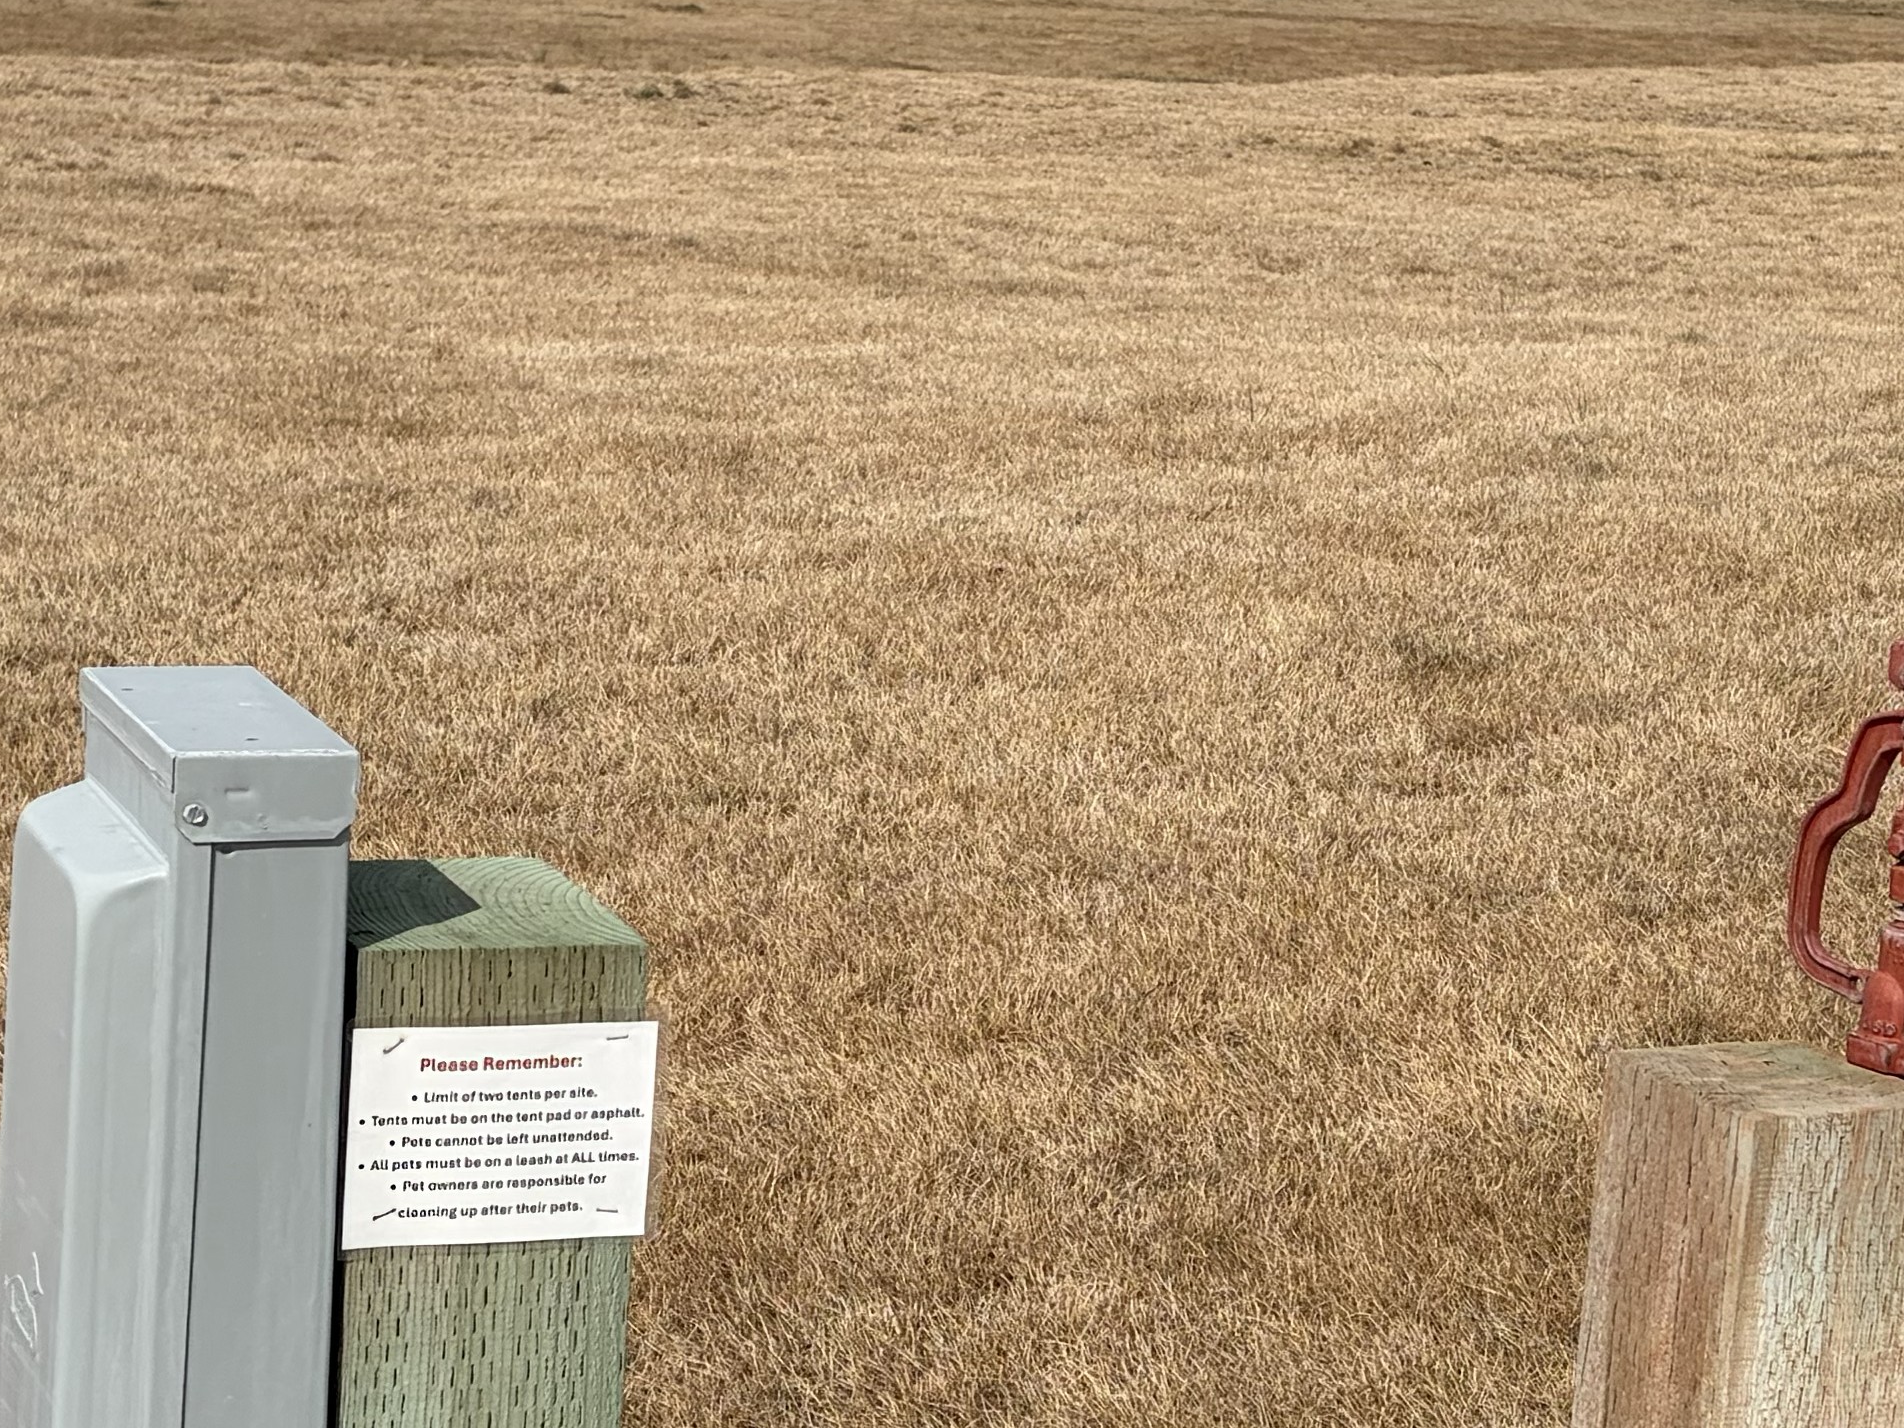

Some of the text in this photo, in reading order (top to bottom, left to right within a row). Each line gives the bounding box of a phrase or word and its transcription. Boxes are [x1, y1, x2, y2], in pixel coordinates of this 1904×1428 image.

[420, 1054, 583, 1073] Please Remember:
[424, 1086, 598, 1104] Limit of two tents per site.
[371, 1107, 645, 1127] Tents must be on the tent pad or asphalt.
[401, 1128, 613, 1148] Pets cannot be left unattended.
[369, 1151, 639, 1172] All pets must be on a leash at ALL times.
[402, 1172, 607, 1192] Pet owners are responsible for
[397, 1201, 583, 1220] cleaning up after their pets.
